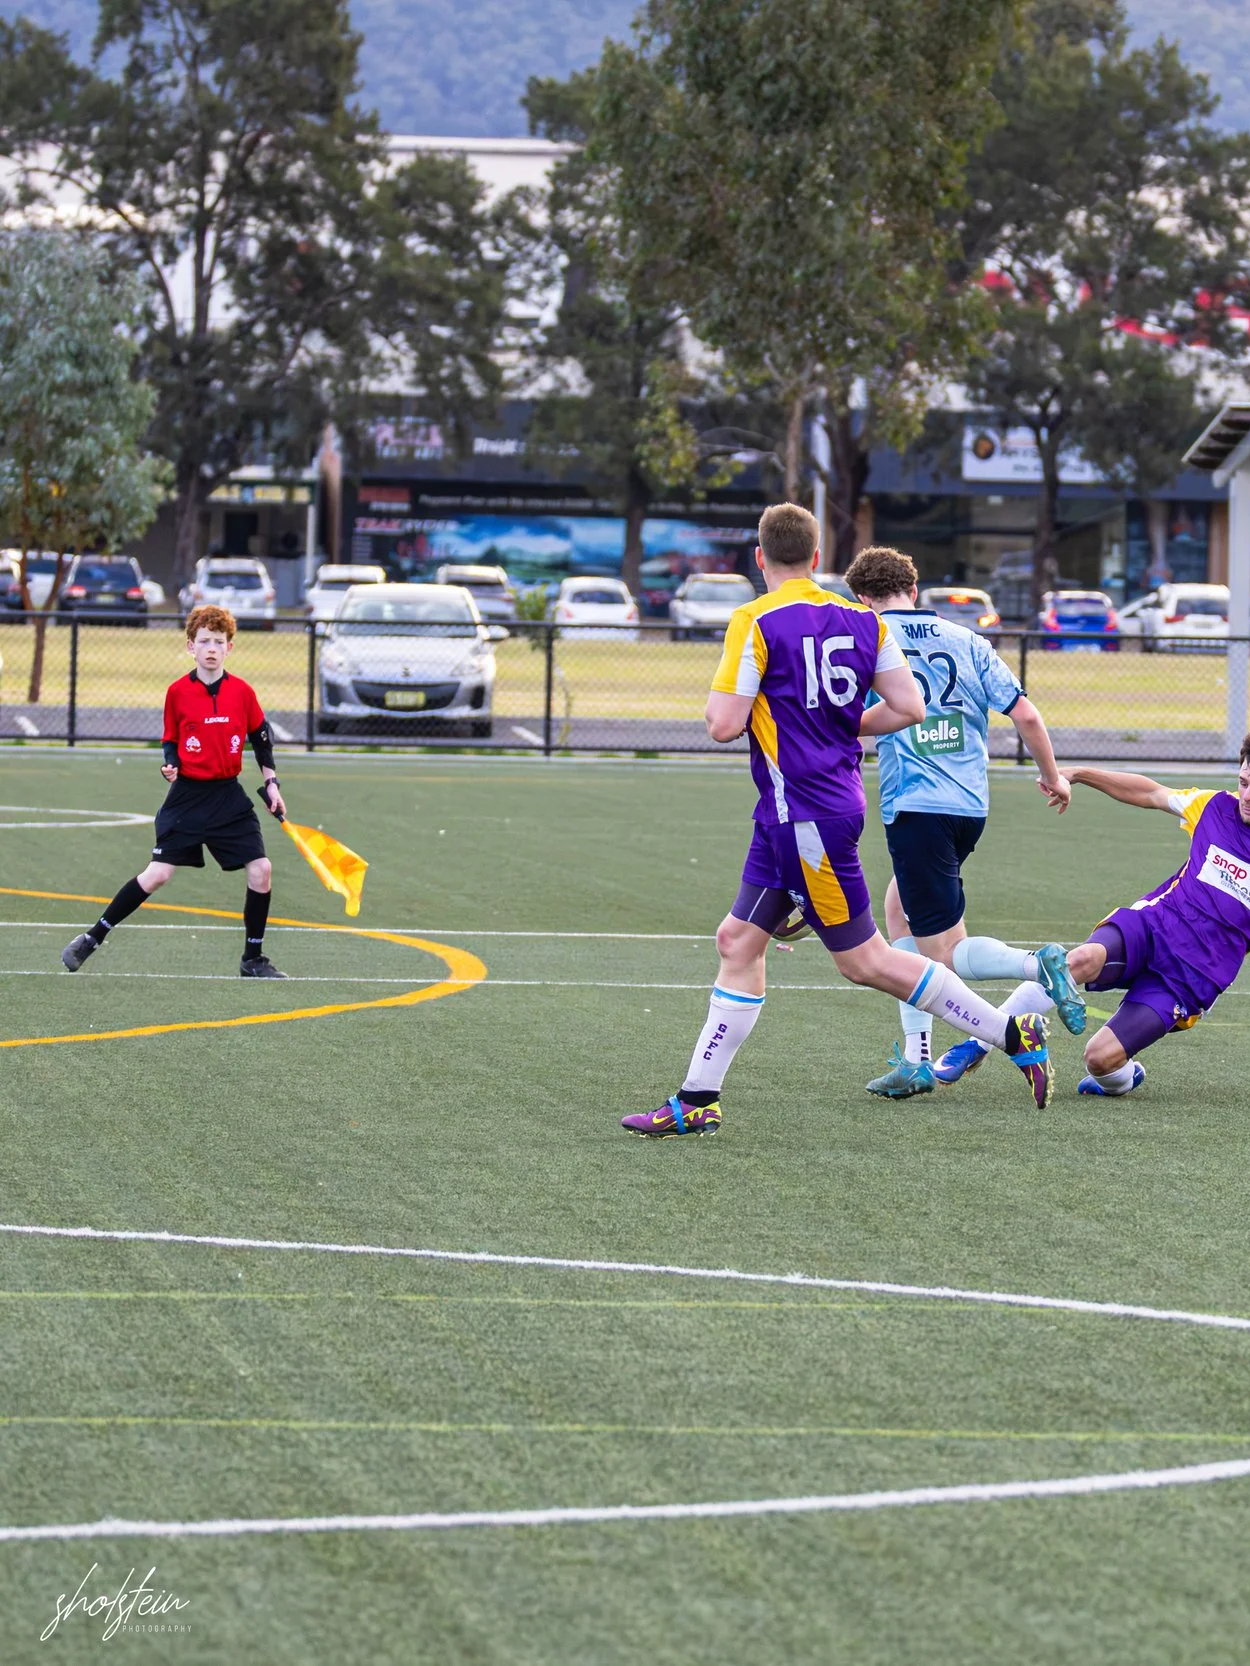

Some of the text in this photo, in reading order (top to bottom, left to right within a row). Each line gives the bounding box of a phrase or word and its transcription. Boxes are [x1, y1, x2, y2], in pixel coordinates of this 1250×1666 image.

[802, 635, 858, 709] 16
[910, 719, 960, 743] belle
[1212, 854, 1247, 880] snap
[945, 999, 980, 1026] GPFC
[703, 1023, 728, 1060] GPFC
